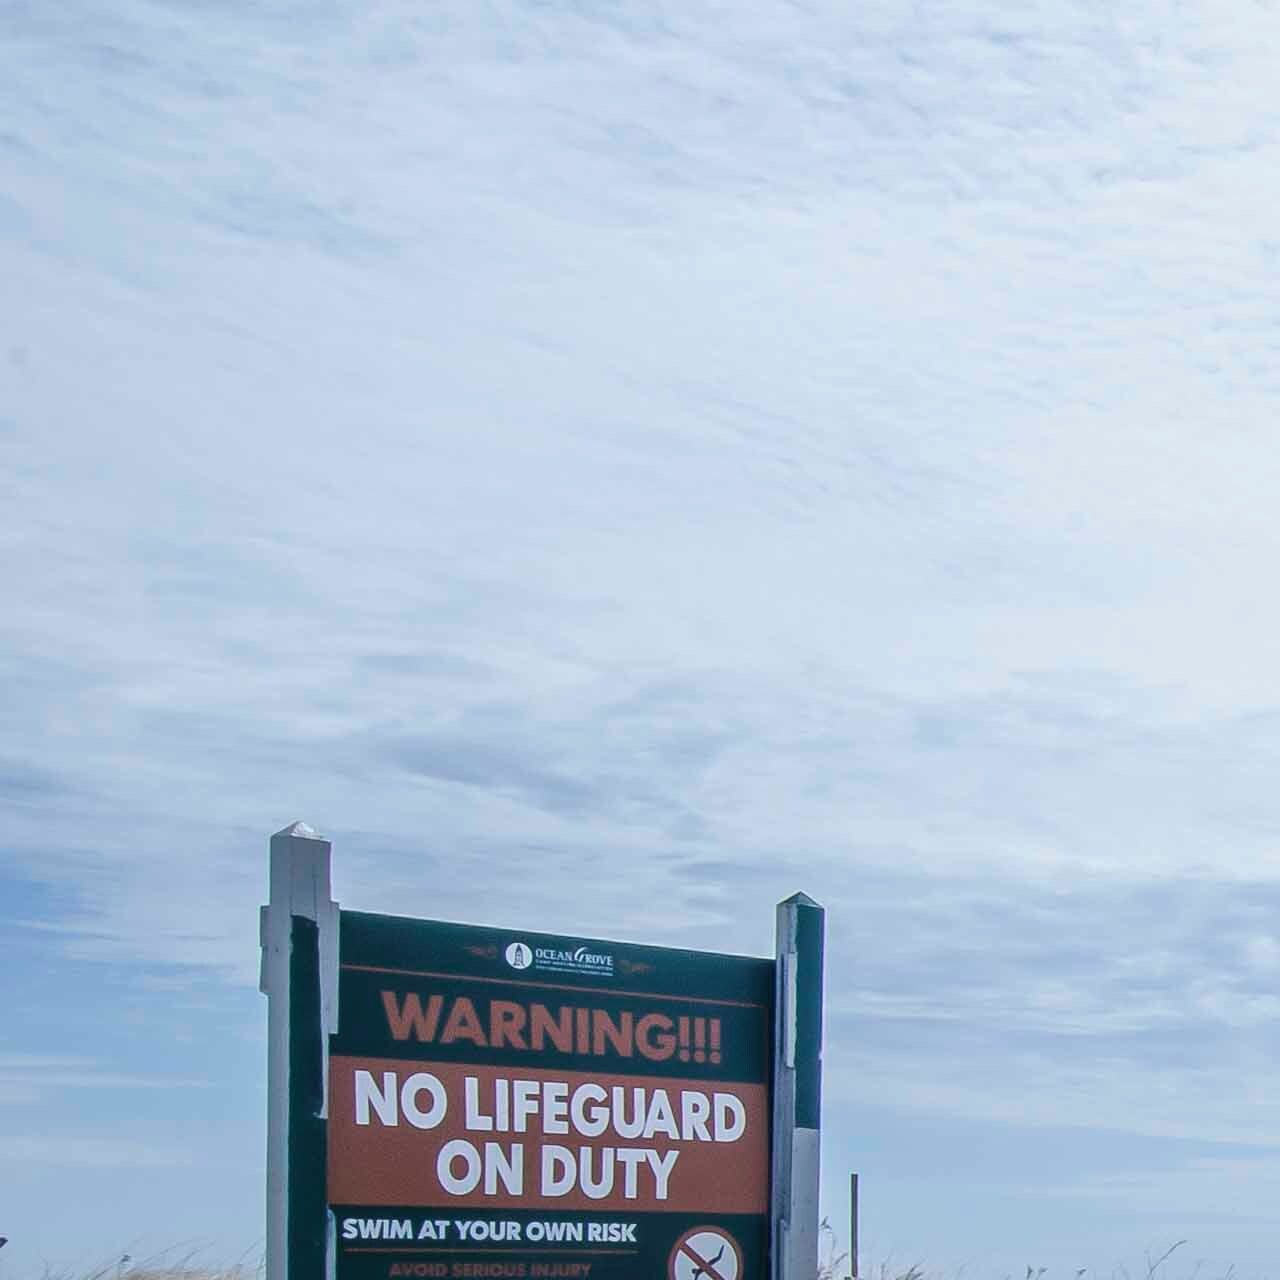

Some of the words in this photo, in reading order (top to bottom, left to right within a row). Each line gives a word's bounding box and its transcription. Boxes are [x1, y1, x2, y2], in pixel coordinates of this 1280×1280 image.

[381, 991, 722, 1064] WARNING!!!
[354, 1070, 448, 1129] NO
[464, 1076, 746, 1142] LIFEGUARD
[436, 1139, 523, 1196] ON
[541, 1144, 679, 1200] DUTY
[342, 1218, 411, 1239] SWIM
[418, 1220, 450, 1239] AT
[455, 1220, 521, 1241] YOUR
[526, 1222, 582, 1241] OWN
[588, 1223, 637, 1242] RISK
[389, 1264, 448, 1277] AVOID
[452, 1264, 526, 1277] SERIOUS
[531, 1264, 592, 1277] INJURY
